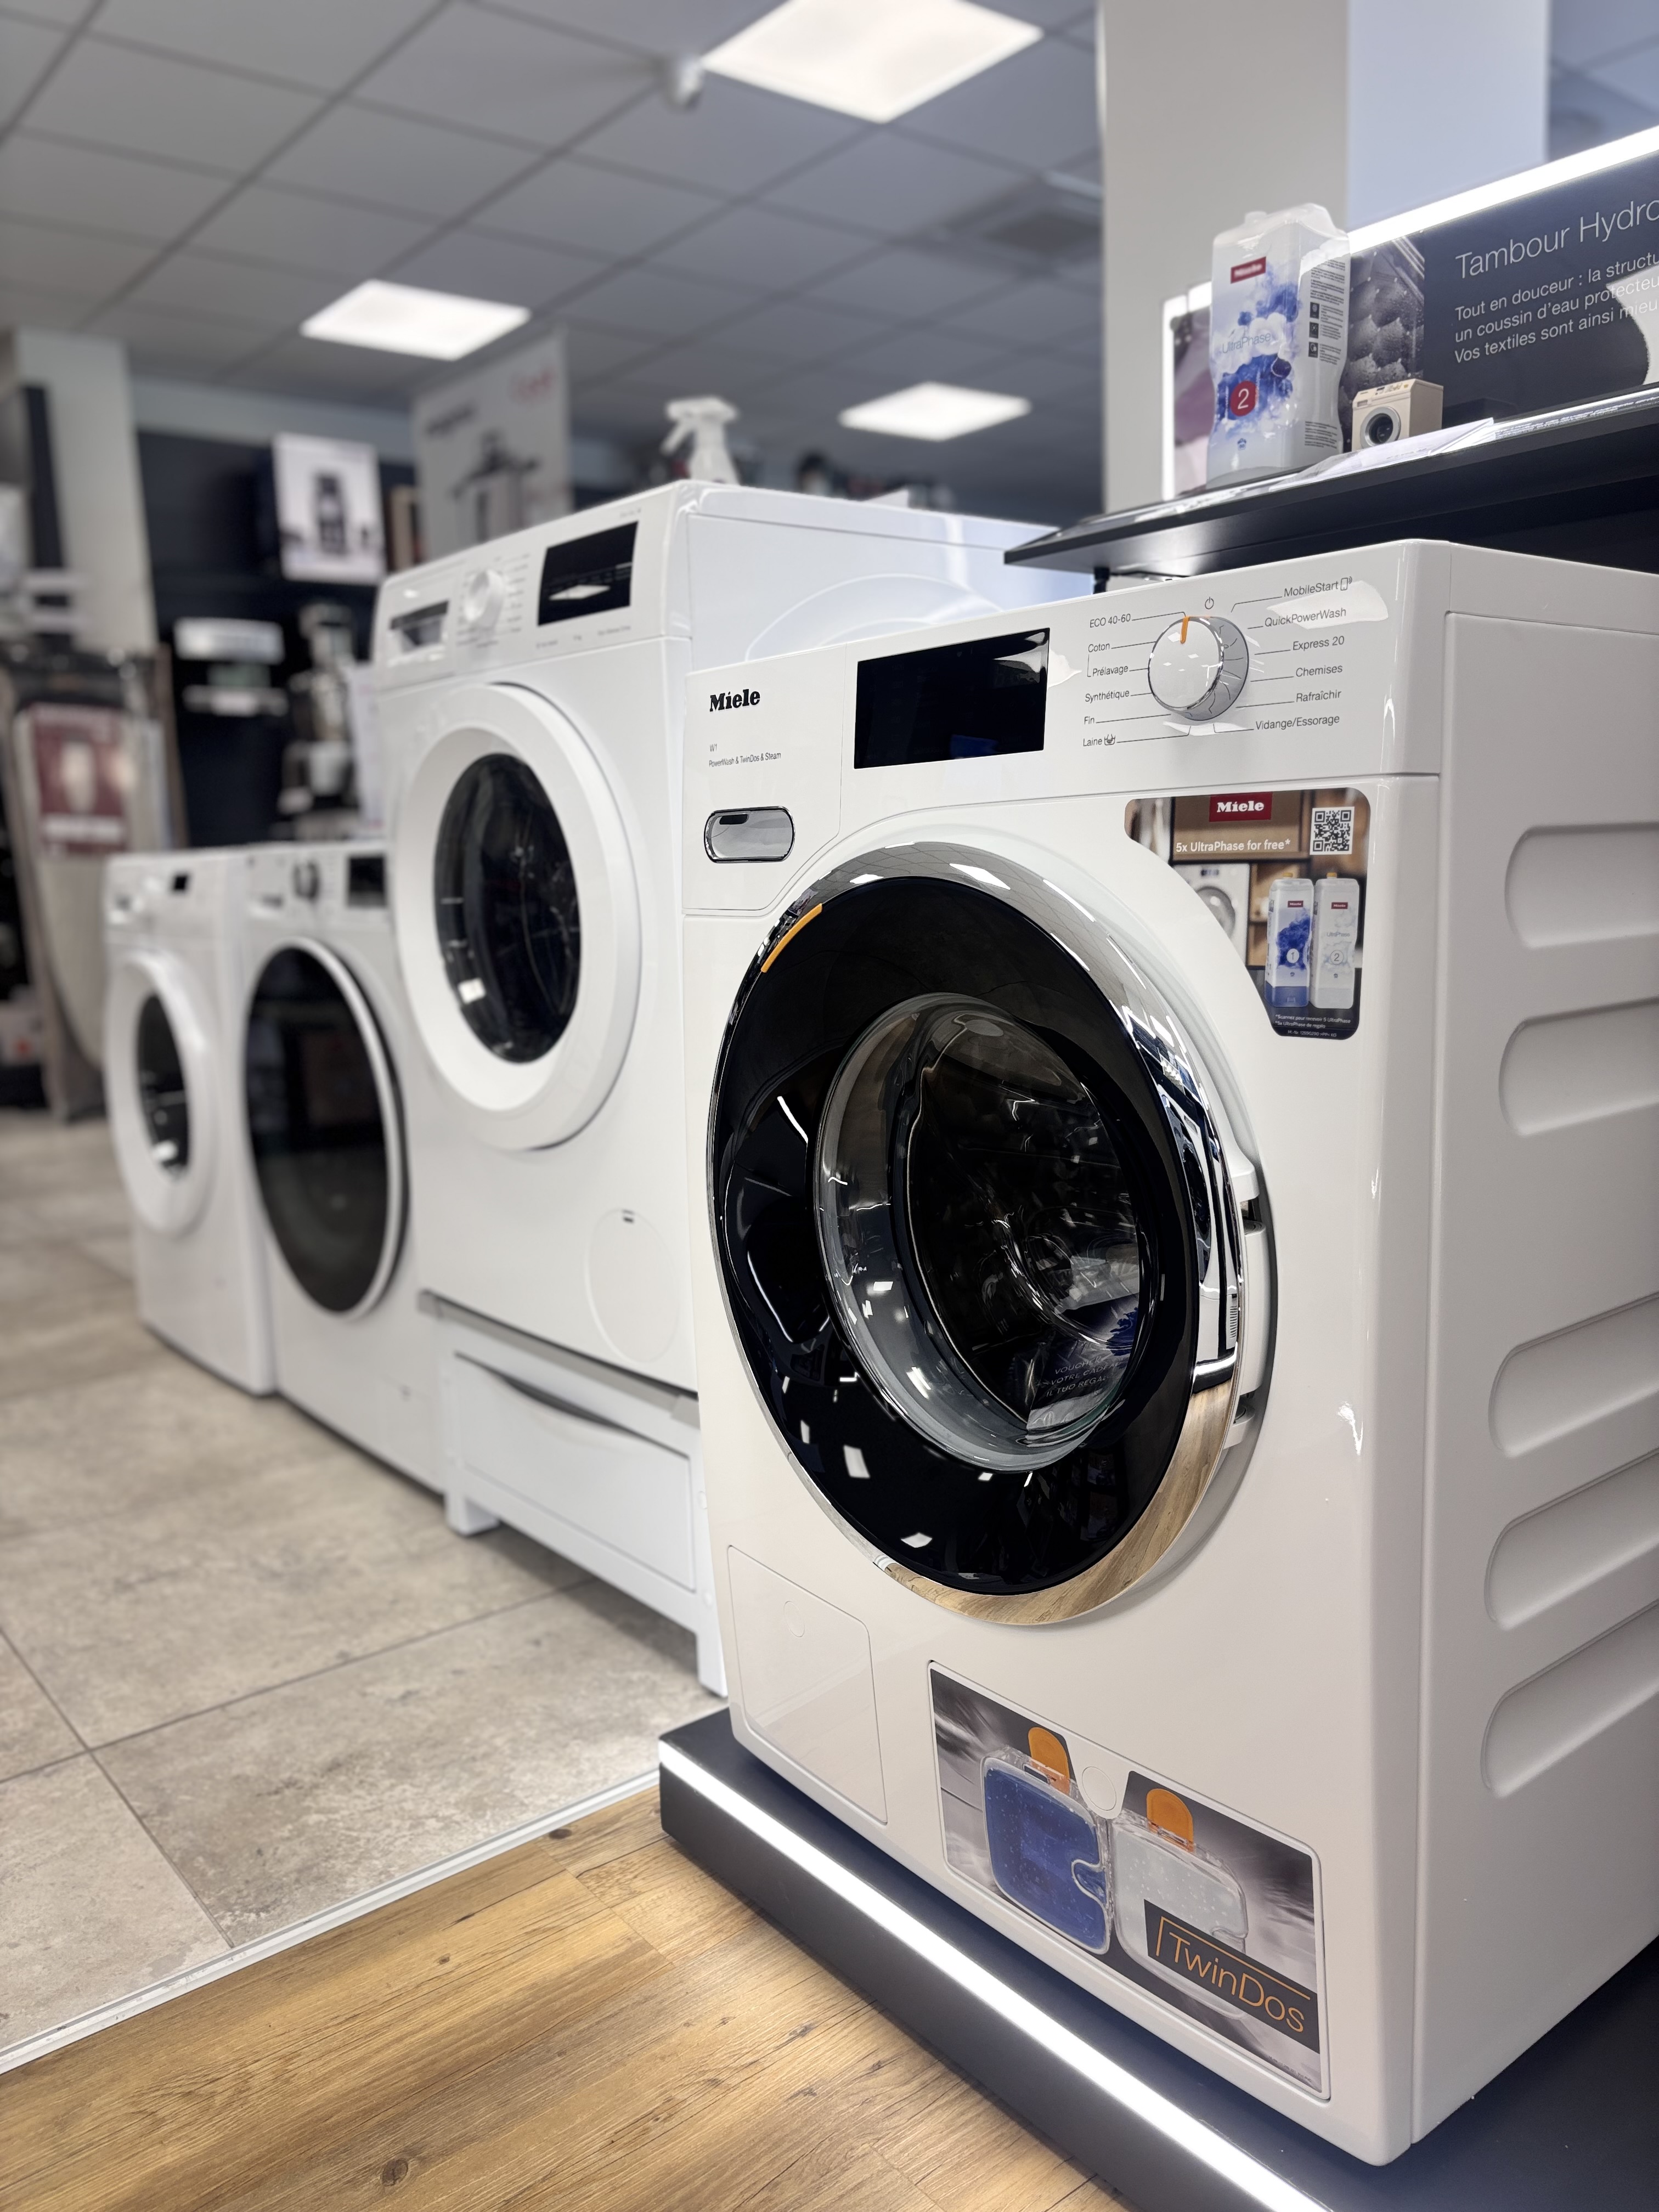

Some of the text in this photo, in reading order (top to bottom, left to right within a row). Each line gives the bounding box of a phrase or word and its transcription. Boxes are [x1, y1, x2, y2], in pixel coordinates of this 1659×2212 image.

[1455, 201, 1659, 279] Tambour Hydro
[1455, 301, 1485, 321] Tout
[1490, 297, 1506, 311] en
[1512, 277, 1574, 304] douceur
[1579, 275, 1582, 286] :
[1588, 268, 1601, 283] la
[1455, 329, 1472, 342] un
[1477, 311, 1532, 336] coussin
[1454, 347, 1480, 363] Vos
[1485, 331, 1536, 355] textiles
[1541, 319, 1573, 340] sont
[1578, 307, 1613, 330] ainsi
[1222, 333, 1271, 354] UltraPhase
[1238, 388, 1249, 409] 2
[1284, 580, 1339, 597] MobileStart
[1090, 613, 1131, 628] ECO 40-60
[1265, 607, 1346, 627] QuickPowerWash
[1088, 643, 1110, 653] Coton
[1293, 635, 1345, 651] Express 20
[1092, 665, 1128, 676] Prélavage
[1296, 664, 1343, 677] Chemises
[709, 689, 760, 712] Miele
[1085, 690, 1130, 704] Synthétique
[1296, 689, 1342, 703] Rafraîchir
[1084, 715, 1094, 725] Fin
[1255, 715, 1340, 730] Vidange/Essorage
[1083, 737, 1102, 747] Laine
[709, 758, 734, 768] PowerWash
[740, 754, 759, 763] TwinDos
[760, 753, 764, 761] &
[765, 752, 781, 760] Steam
[1216, 800, 1264, 812] Miele
[1176, 842, 1188, 853] 5x
[1190, 840, 1244, 852] UltraPhase
[1247, 839, 1262, 850] for
[1334, 953, 1340, 962] 2
[1052, 1372, 1081, 1385] VOTRE
[1046, 1389, 1053, 1397] IL
[1057, 1384, 1075, 1394] TUO
[1169, 1932, 1305, 2033] TwinDos
